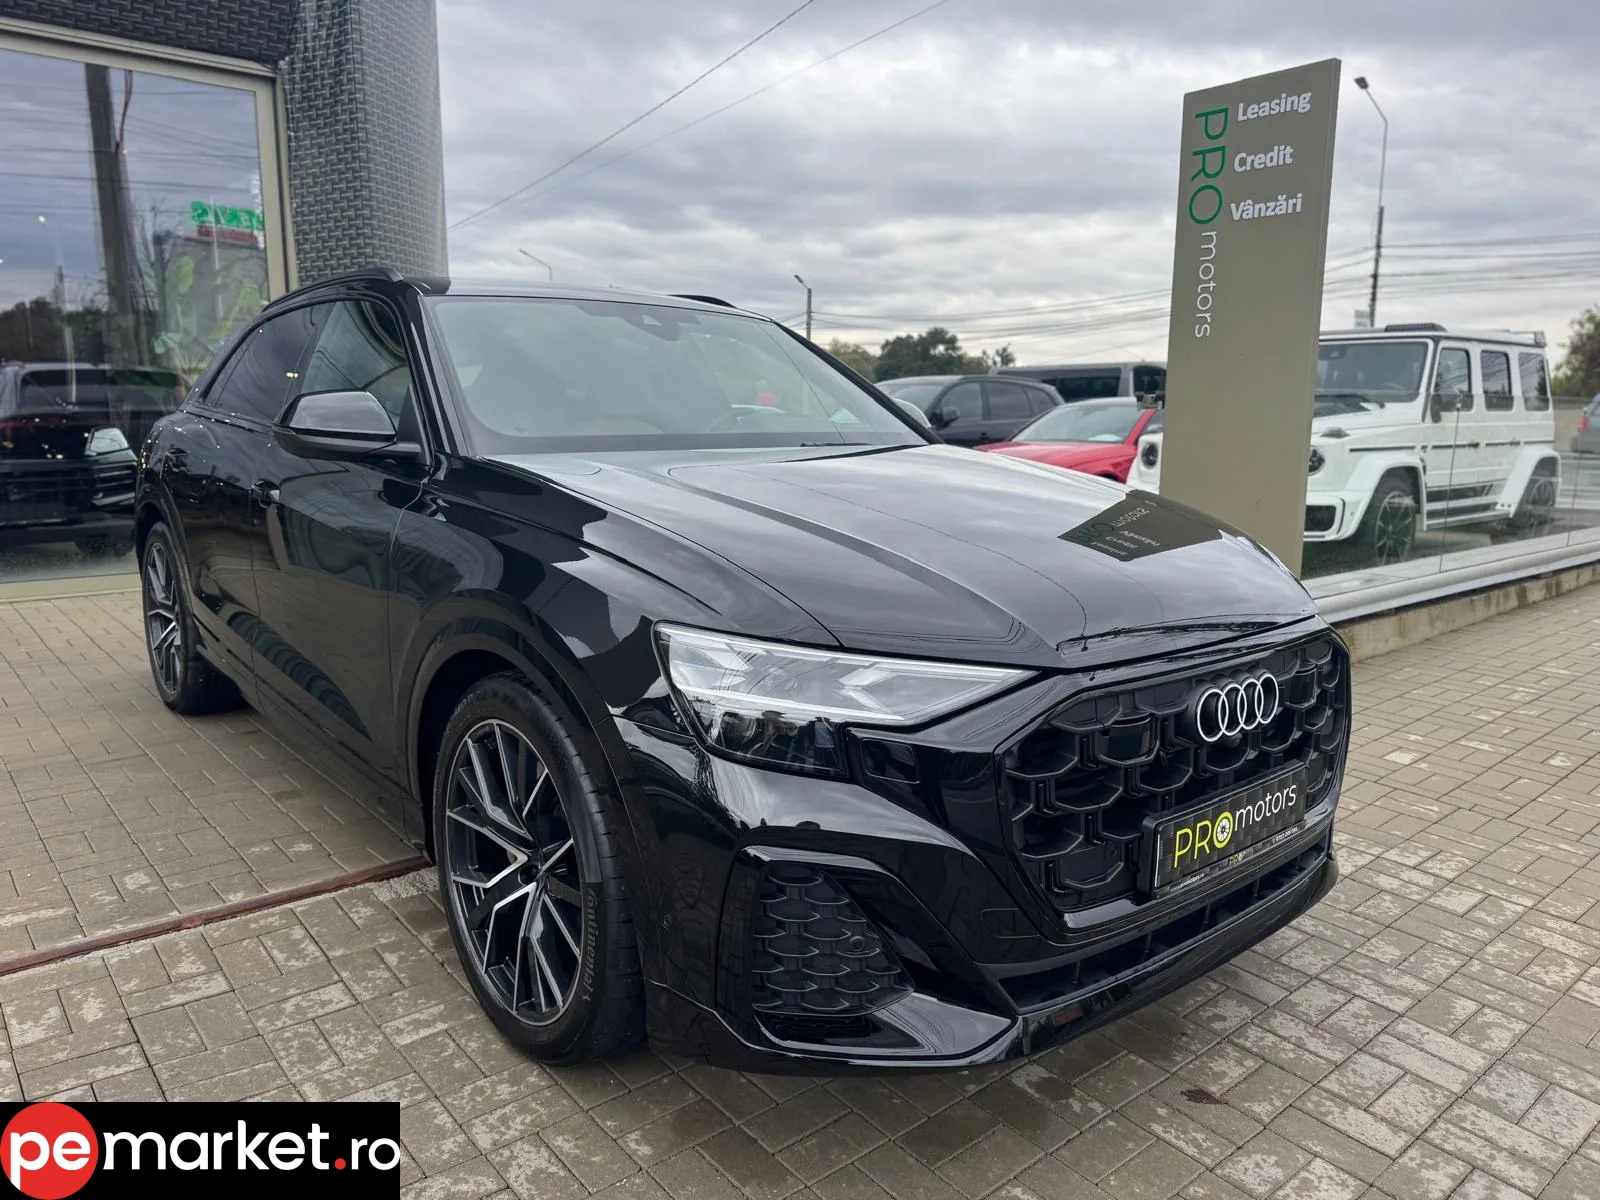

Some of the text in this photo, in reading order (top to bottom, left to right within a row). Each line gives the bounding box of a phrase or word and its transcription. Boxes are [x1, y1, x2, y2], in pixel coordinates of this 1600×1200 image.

[1237, 92, 1312, 121] Leasing
[1233, 144, 1294, 172] Credit
[1230, 192, 1303, 220] Vânzări
[583, 887, 599, 993] Continental
